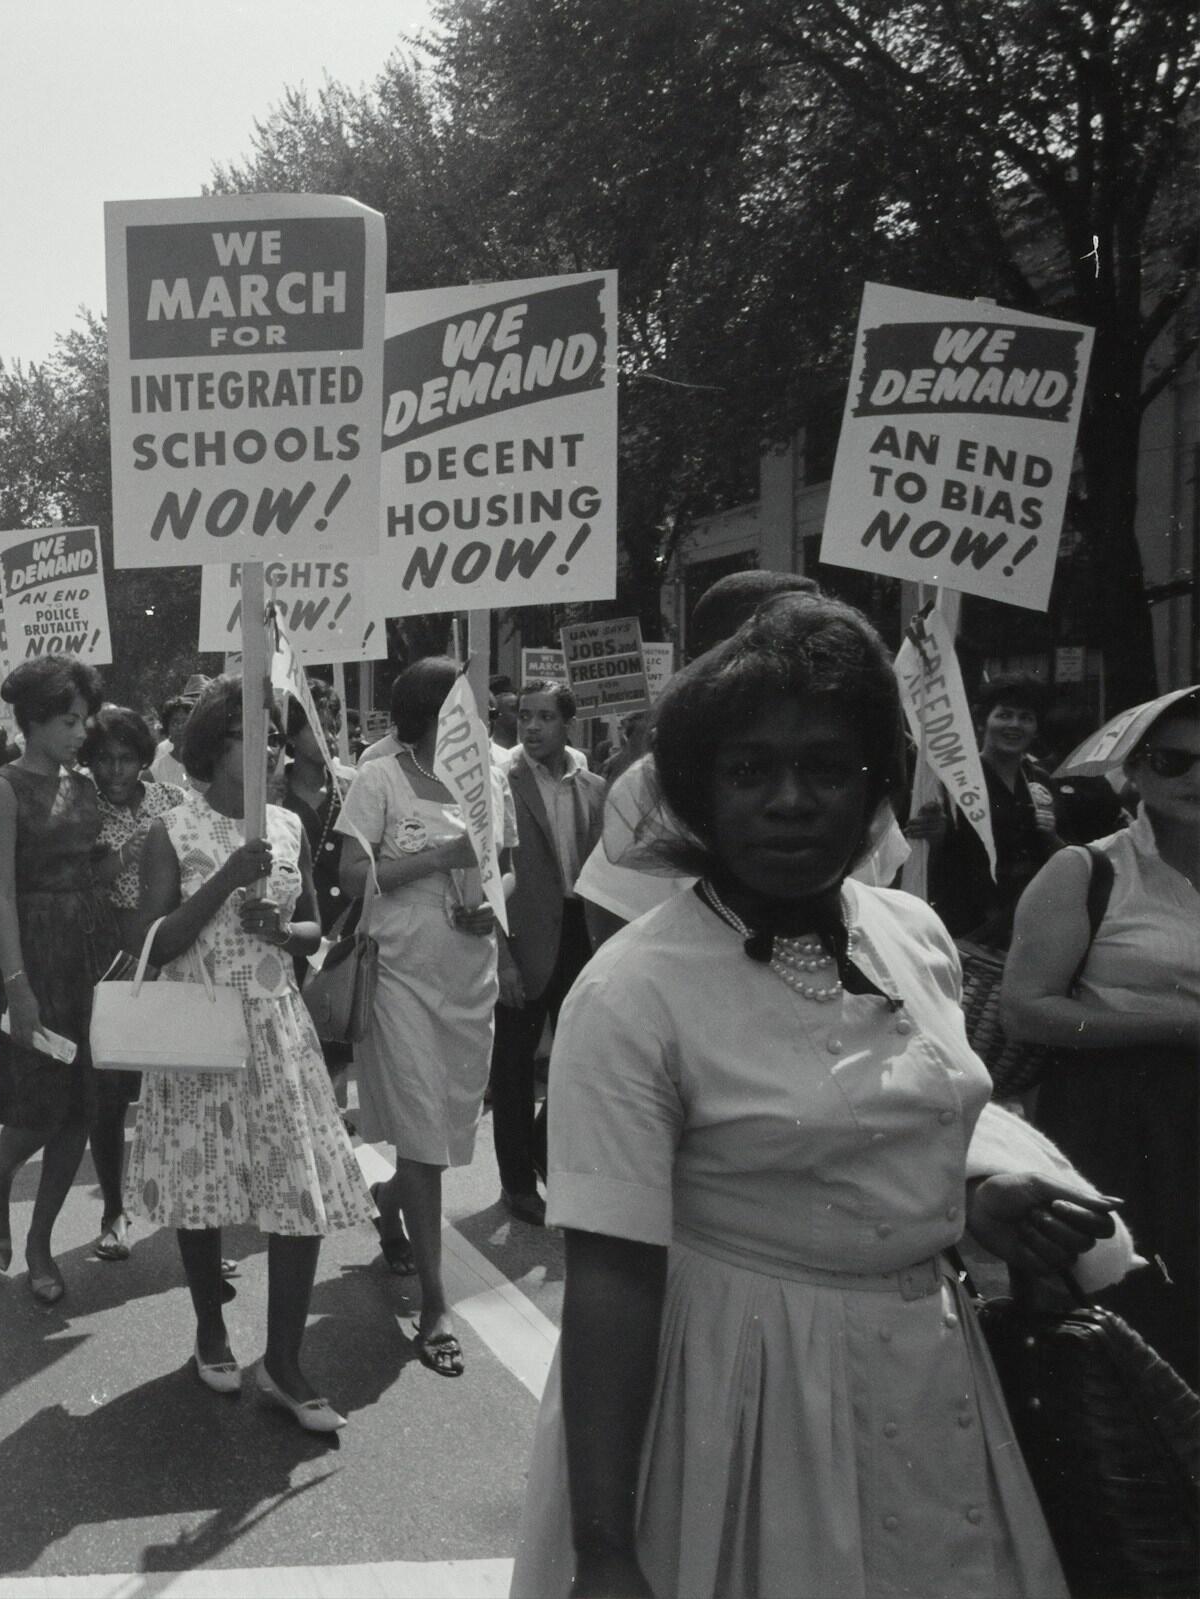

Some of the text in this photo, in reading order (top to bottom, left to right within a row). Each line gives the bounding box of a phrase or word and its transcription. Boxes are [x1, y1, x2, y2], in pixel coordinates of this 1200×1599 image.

[212, 230, 282, 266] WE
[146, 270, 347, 322] MARCH
[210, 324, 287, 348] FOR
[442, 303, 528, 368] WE
[933, 327, 1015, 364] WE
[130, 365, 363, 414] INTEGRATED
[383, 333, 597, 437] DEMAND
[869, 366, 1068, 408] DEMAND
[133, 424, 361, 470] SCHOOLS
[405, 433, 584, 484] DECENT
[869, 425, 1053, 488] AN END
[150, 473, 351, 541] NOW!
[387, 486, 601, 538] HOUSING
[869, 465, 1043, 530] TO BIAS
[32, 535, 66, 560] WE
[401, 522, 591, 591] NOW!
[861, 510, 1038, 577] NOW!
[10, 549, 93, 590] DEMAND
[230, 562, 349, 588] RGHTS
[19, 589, 90, 605] AN END
[36, 607, 80, 622] POLICE
[227, 592, 351, 632] W!
[24, 620, 89, 636] BRUTALITY
[25, 628, 101, 658] NOW!
[570, 629, 599, 641] UAW
[528, 662, 566, 671] MARCH
[569, 639, 616, 661] JOBS
[571, 657, 642, 682] FREEDOM
[437, 704, 490, 837] FREEDOM
[953, 770, 967, 787] IN
[960, 786, 985, 822] '63
